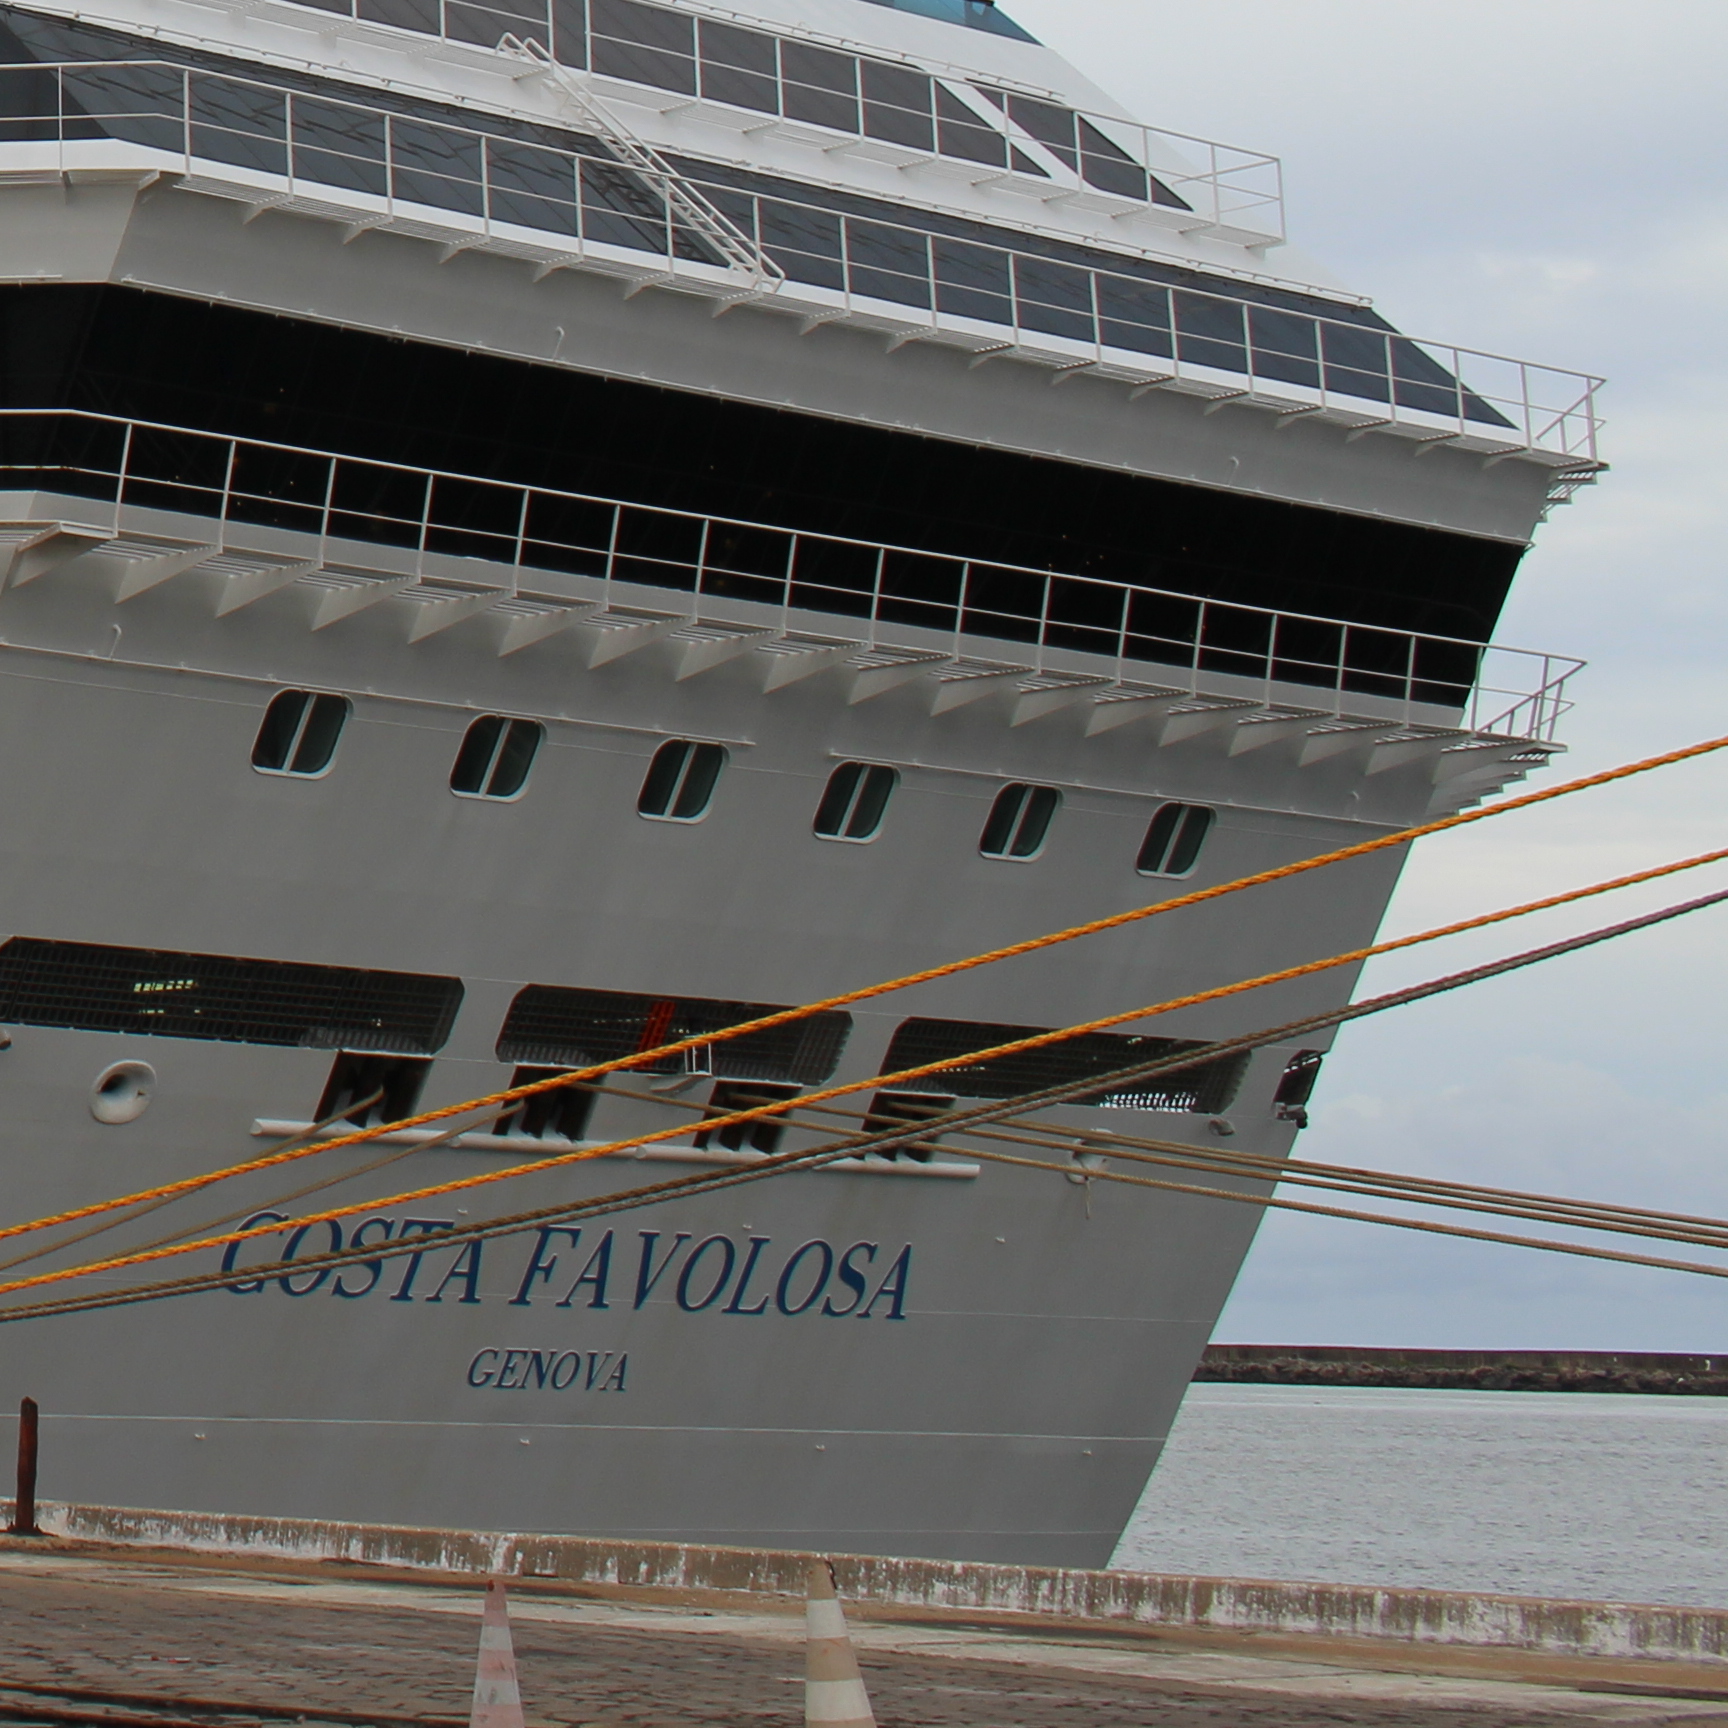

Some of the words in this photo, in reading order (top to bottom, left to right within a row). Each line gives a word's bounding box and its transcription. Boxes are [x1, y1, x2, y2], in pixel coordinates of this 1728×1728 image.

[220, 1209, 485, 1304] COSTA
[507, 1224, 913, 1320] FAVOLOSA
[467, 1346, 628, 1392] GENOVA
